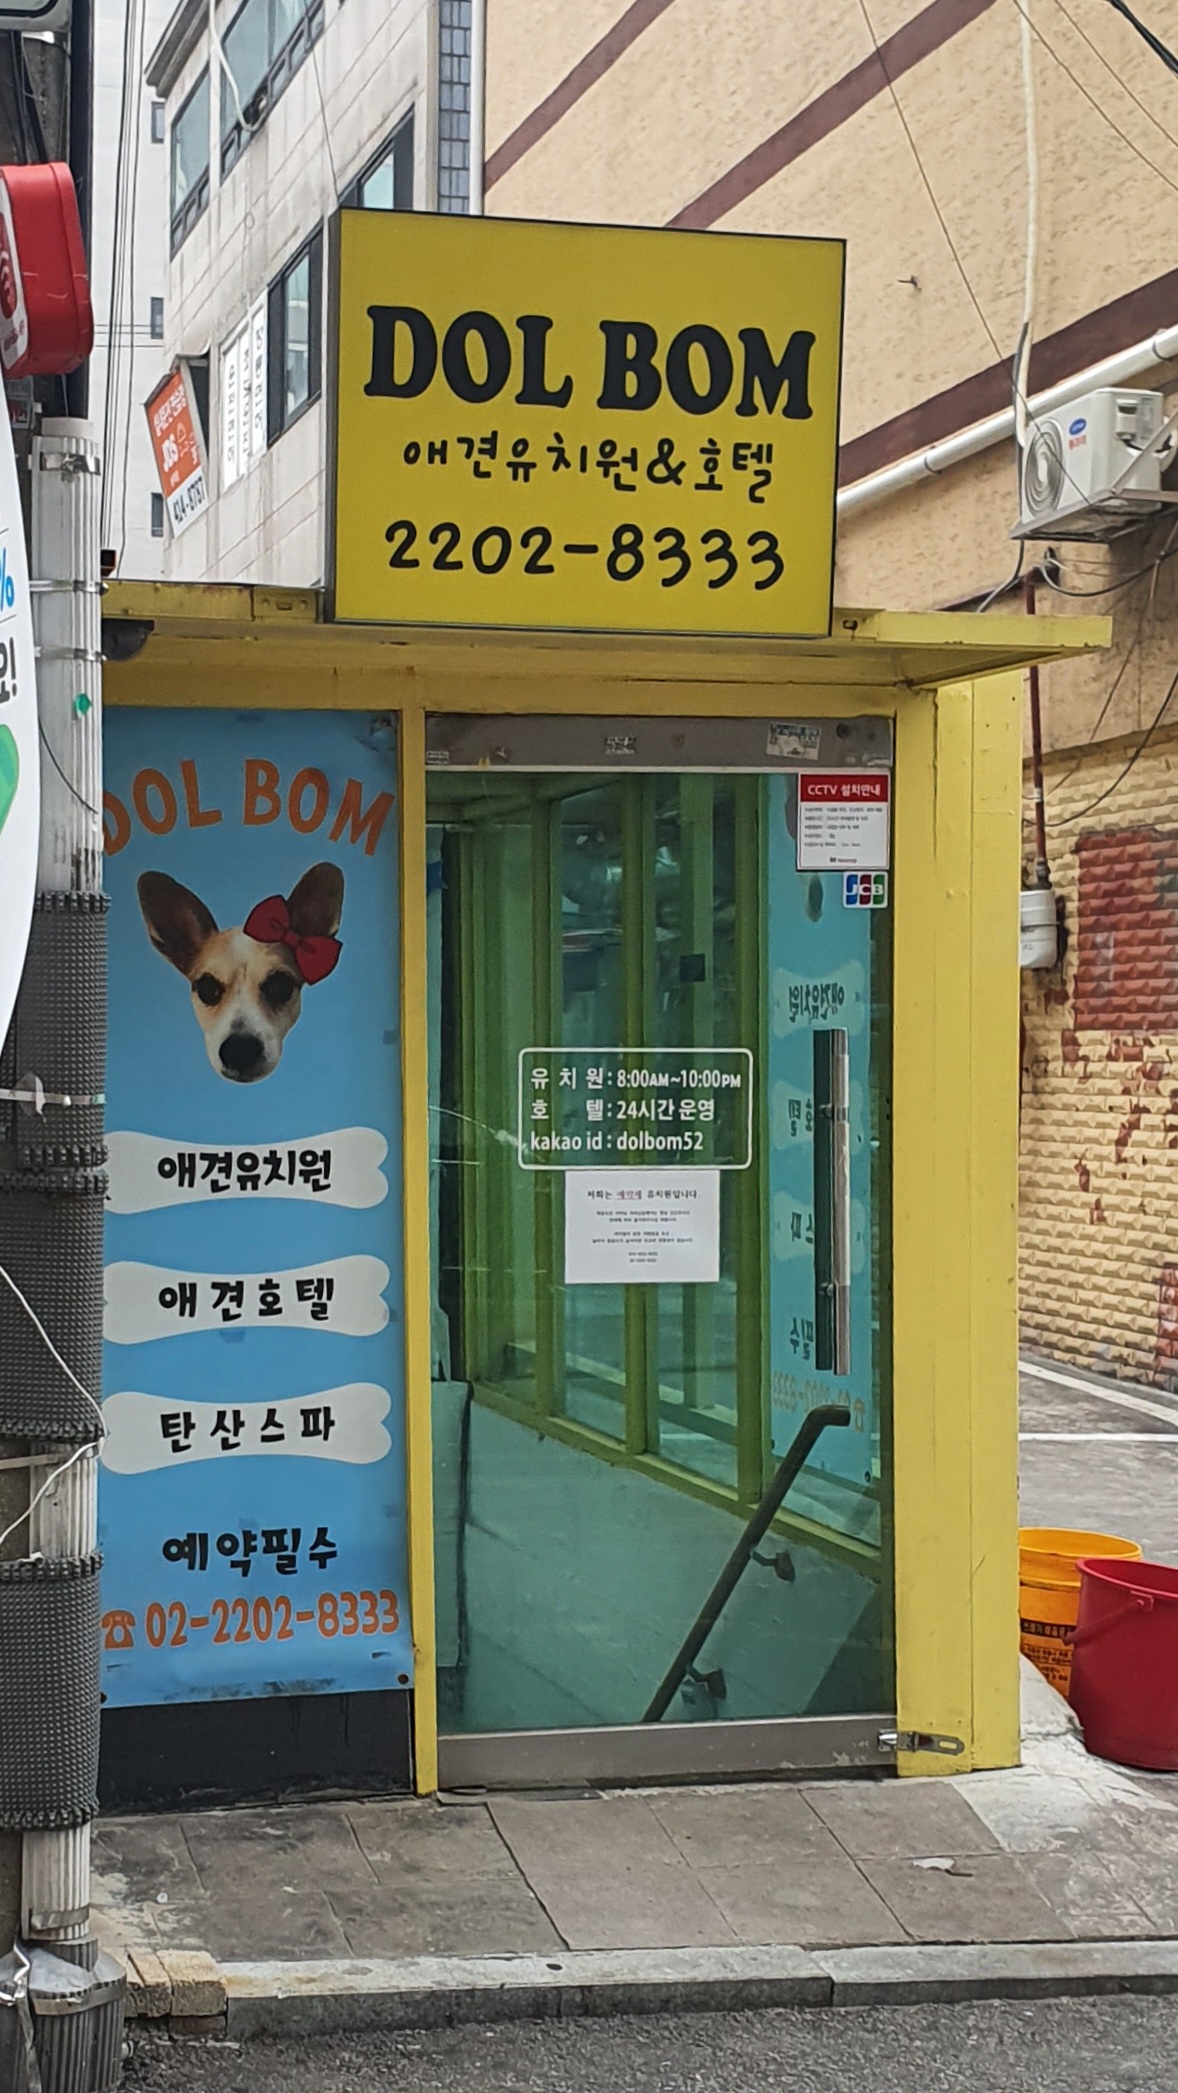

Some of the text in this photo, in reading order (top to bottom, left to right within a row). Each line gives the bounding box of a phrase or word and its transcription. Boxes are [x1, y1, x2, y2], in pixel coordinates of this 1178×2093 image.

[363, 305, 573, 409] DOL
[597, 320, 816, 420] BOM
[403, 430, 773, 504] 애견유치원&호텔
[385, 519, 784, 590] 2202-8333
[243, 758, 395, 857] BOM
[807, 784, 881, 796] CCTV 설치안내
[616, 1099, 675, 1121] 24시간
[679, 1099, 715, 1121] 운영
[531, 1131, 582, 1150] kakao
[586, 1131, 602, 1150] id
[616, 1131, 704, 1150] dolbom52
[158, 1148, 333, 1193] 애견유치원
[162, 1527, 338, 1578] 예약필수
[146, 1589, 400, 1648] 02-2202-8333
